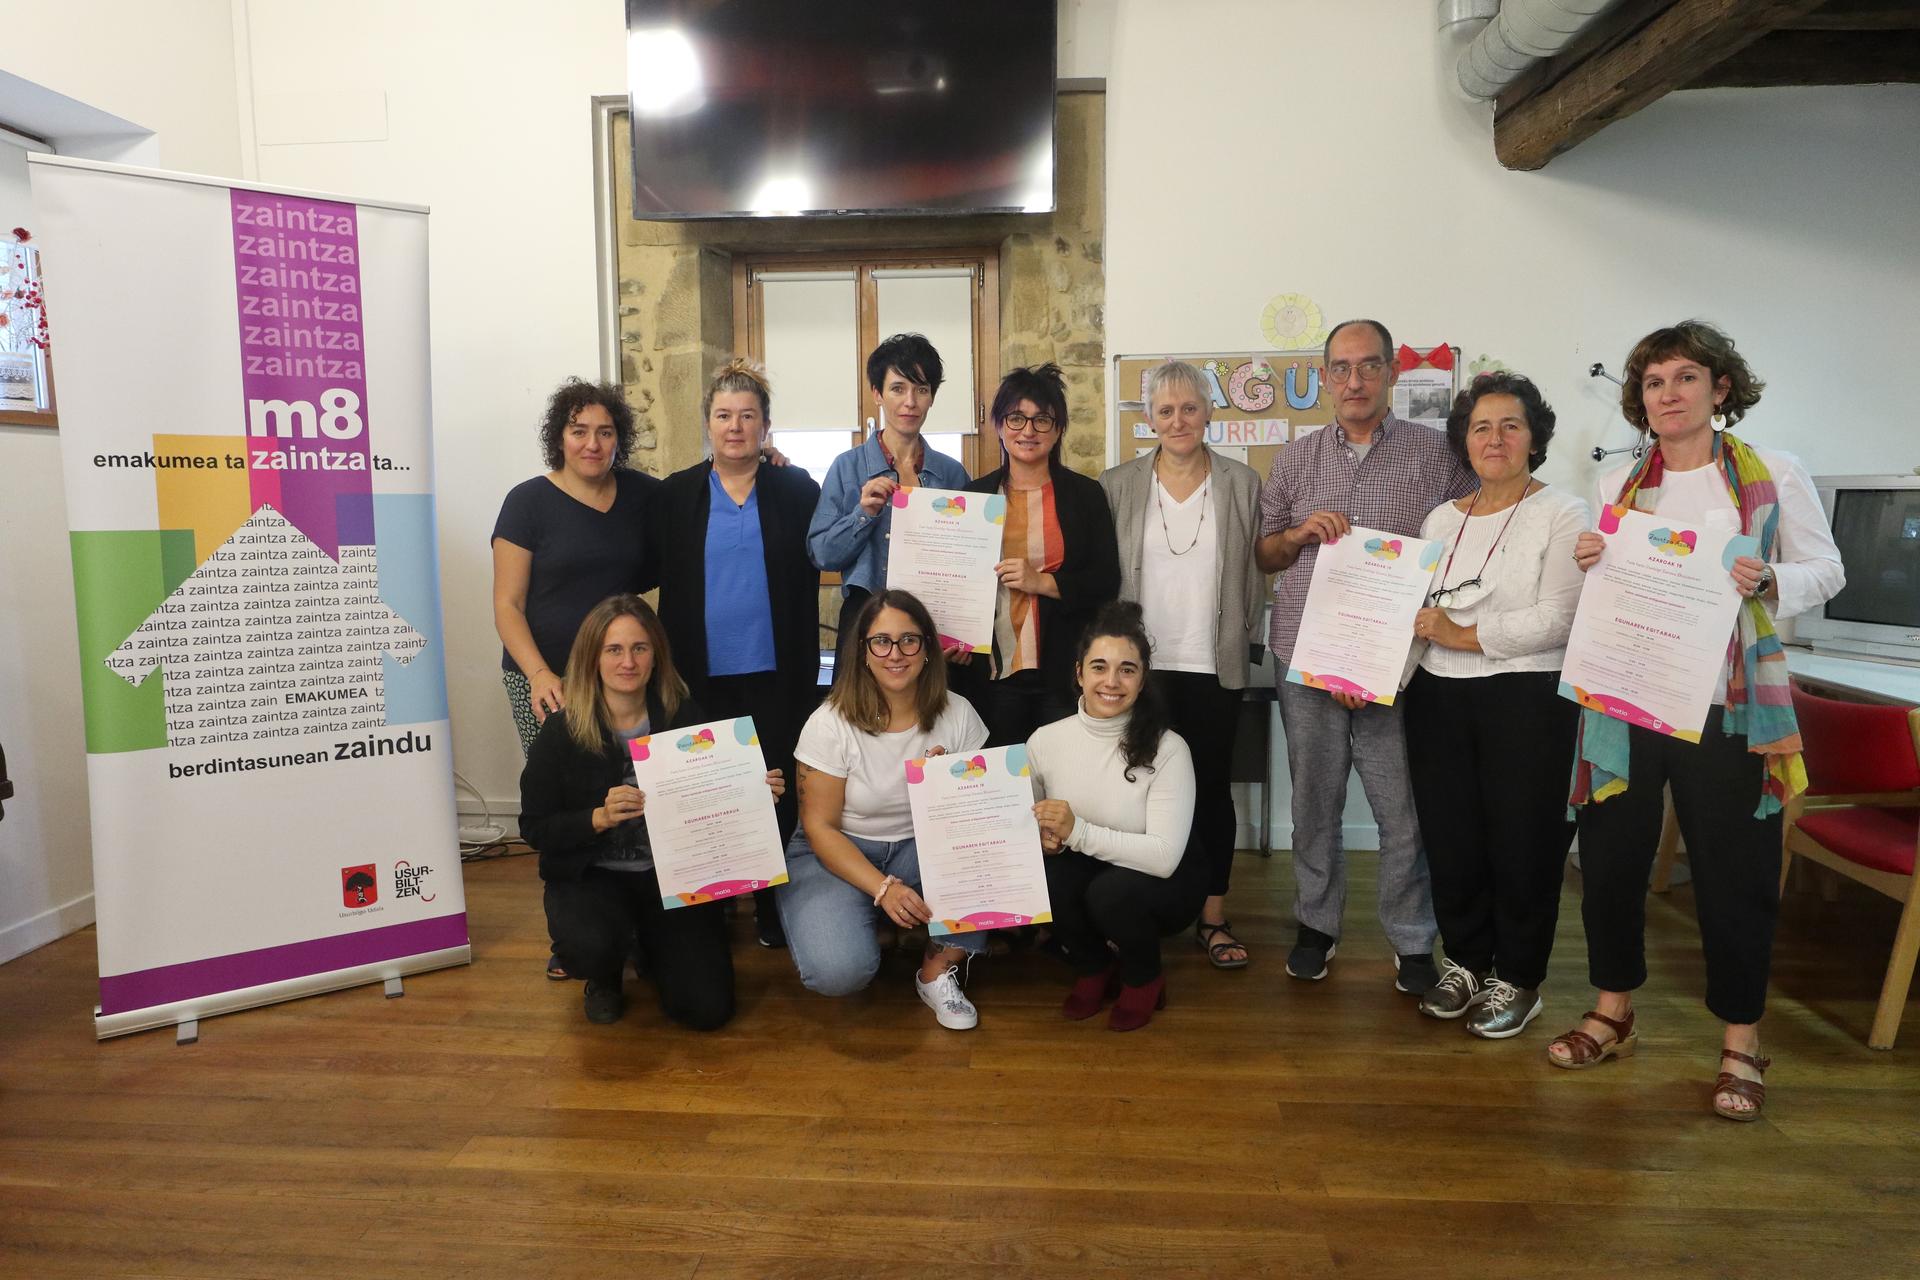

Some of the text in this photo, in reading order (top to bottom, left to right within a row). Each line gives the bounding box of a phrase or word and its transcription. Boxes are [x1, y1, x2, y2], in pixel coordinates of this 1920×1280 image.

[237, 203, 353, 236] zaintza
[239, 233, 355, 265] zaintza
[241, 263, 356, 294] zaintza
[243, 292, 358, 322] zaintza
[245, 322, 360, 351] zaintza
[247, 352, 362, 380] zaintza
[249, 388, 363, 440] m8
[93, 445, 410, 471] emakumea ta zaintza ta...
[239, 532, 287, 544] zaintza
[240, 549, 288, 560] zaintza
[242, 565, 289, 578] zaintza
[292, 563, 338, 576] zaintza
[189, 584, 238, 596] zaintza
[243, 581, 290, 593] zaintza
[294, 580, 340, 592] zaintza
[190, 600, 240, 612] zaintza
[244, 598, 291, 610] zaintza
[295, 596, 340, 608] zaintza
[136, 620, 186, 632] zaintza
[192, 618, 240, 629] zaintza
[246, 614, 292, 626] zaintza
[296, 612, 341, 624] zaintza
[345, 610, 389, 622] zaintza
[138, 637, 188, 650] zaintza
[193, 634, 242, 646] zaintza
[246, 630, 293, 643] zaintza
[297, 628, 342, 640] zaintza
[346, 626, 390, 637] zaintza
[139, 654, 189, 666] zaintza
[194, 650, 242, 662] zaintza
[248, 646, 294, 660] zaintza
[298, 644, 343, 656] zaintza
[347, 641, 390, 653] zaintza
[196, 666, 244, 678] zaintza
[248, 662, 295, 675] zaintza
[299, 659, 344, 672] zaintza
[196, 682, 245, 695] zaintza
[250, 678, 296, 692] zaintza
[300, 675, 345, 688] zaintza
[198, 699, 246, 712] zaintza
[251, 696, 278, 708] zain
[285, 688, 368, 704] EMAKUMEA
[199, 716, 248, 728] zaintza
[252, 710, 298, 724] zaintza
[302, 706, 347, 720] zaintza
[200, 732, 248, 744] zaintza
[253, 726, 300, 740] zaintza
[304, 722, 348, 734] zaintza
[169, 731, 432, 779] berdintasunean zaindu
[395, 865, 434, 880] USUR-
[396, 877, 424, 890] BILT-
[396, 886, 420, 898] ZEN
